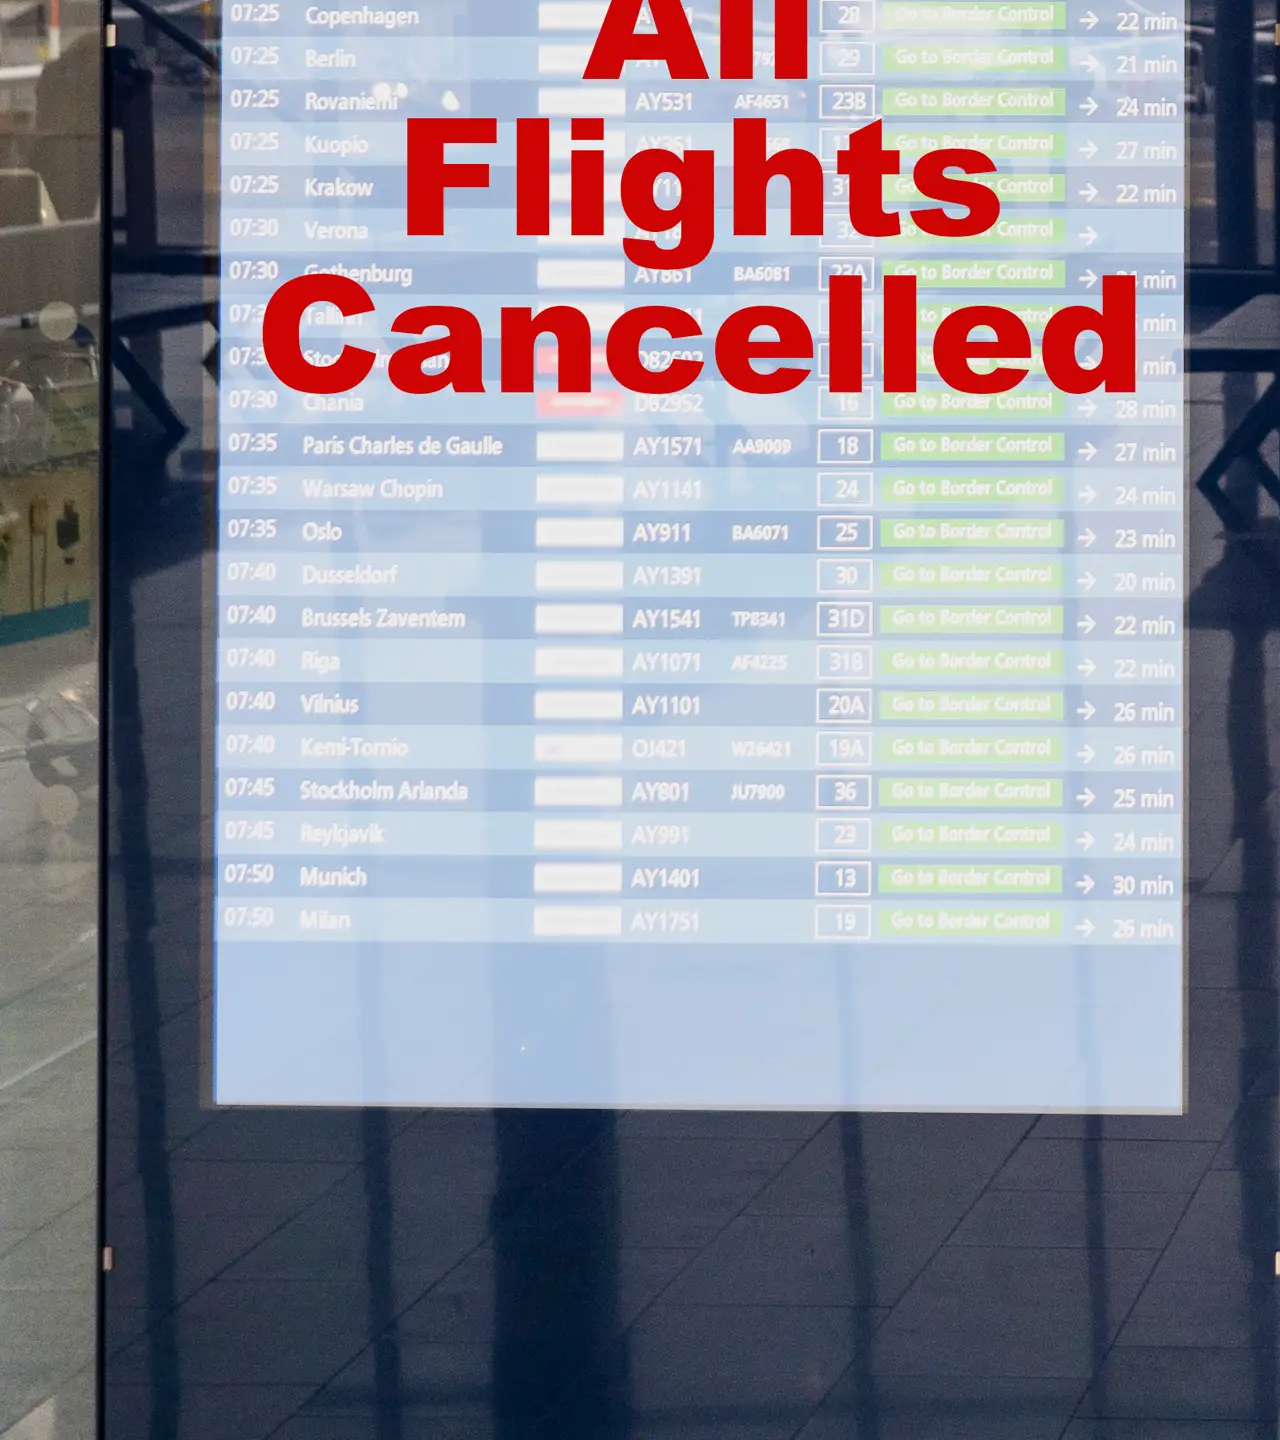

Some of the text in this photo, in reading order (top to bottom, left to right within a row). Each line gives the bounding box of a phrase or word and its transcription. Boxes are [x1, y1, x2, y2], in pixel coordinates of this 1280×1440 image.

[227, 432, 278, 453] 07:35
[303, 434, 345, 456] Paris
[349, 434, 414, 456] Charles
[417, 435, 440, 456] de
[445, 434, 503, 456] Gaulle
[632, 437, 702, 456] AY1571
[837, 435, 860, 456] 18
[1114, 442, 1138, 462] 27
[1142, 441, 1177, 462] min
[227, 518, 1176, 549] 07:35 Oslo AY911 BA6071 25 23 min
[224, 776, 275, 798] 07:45
[300, 777, 394, 801] Stockholm
[397, 779, 468, 801] Arlanda
[631, 781, 690, 803] AY801
[834, 781, 857, 802] 36
[1113, 788, 1136, 809] 25
[1140, 787, 1175, 809] min
[224, 861, 1174, 896] 07:50 Munich AY1401 13 30 min
